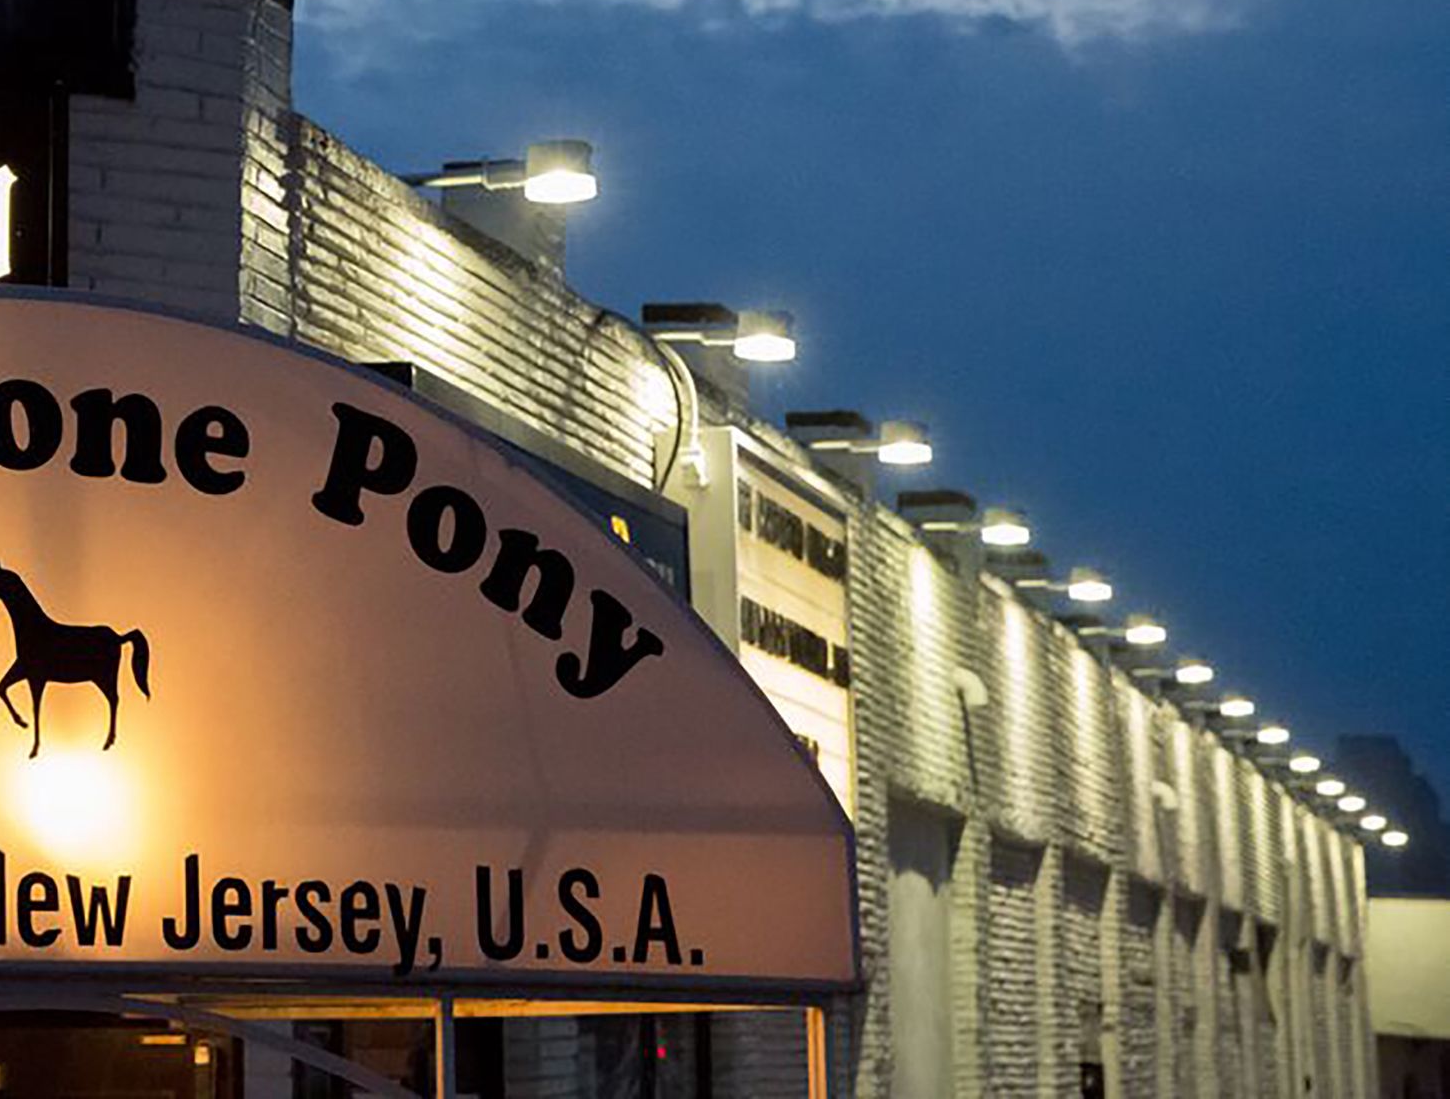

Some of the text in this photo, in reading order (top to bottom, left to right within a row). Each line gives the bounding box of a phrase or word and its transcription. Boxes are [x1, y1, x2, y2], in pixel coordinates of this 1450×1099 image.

[310, 400, 666, 700] Pony
[161, 853, 444, 977] Jersey,
[474, 864, 705, 967] U.S.A.
